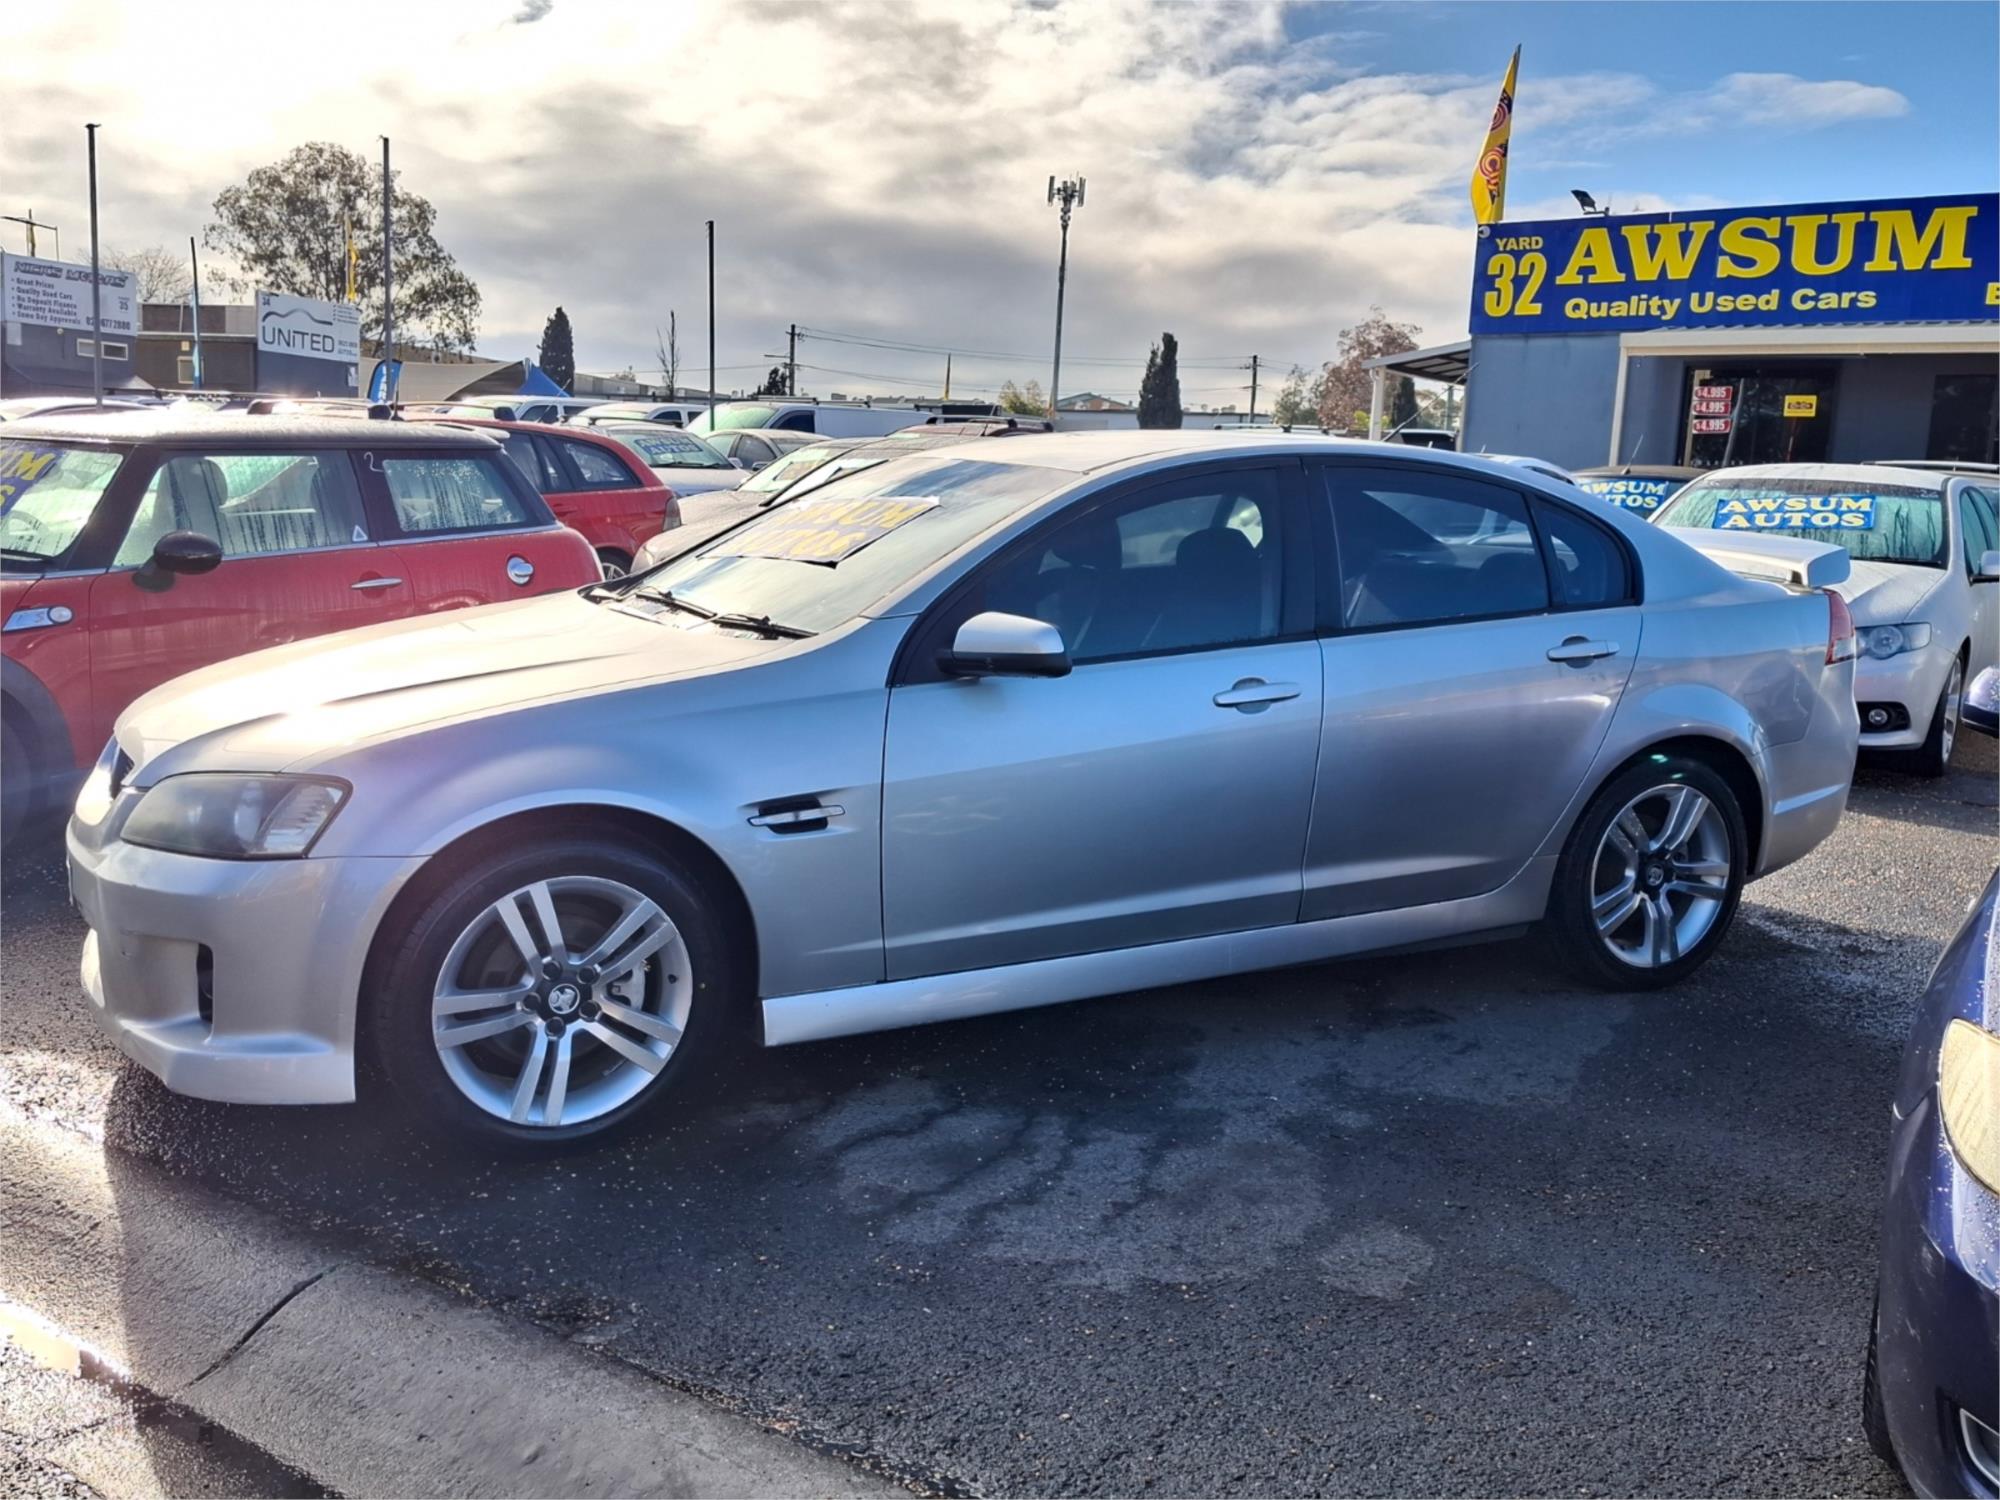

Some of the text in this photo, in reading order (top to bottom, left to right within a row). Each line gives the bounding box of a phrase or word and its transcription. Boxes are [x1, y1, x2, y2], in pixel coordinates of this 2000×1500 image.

[1496, 236, 1544, 250] YARD
[1556, 206, 1978, 285] AWSUM
[1484, 252, 1547, 317] 32
[1564, 287, 1878, 320] Quality Used Cars
[1719, 497, 1873, 514] AWSUM
[1720, 512, 1866, 529] AUTOS
